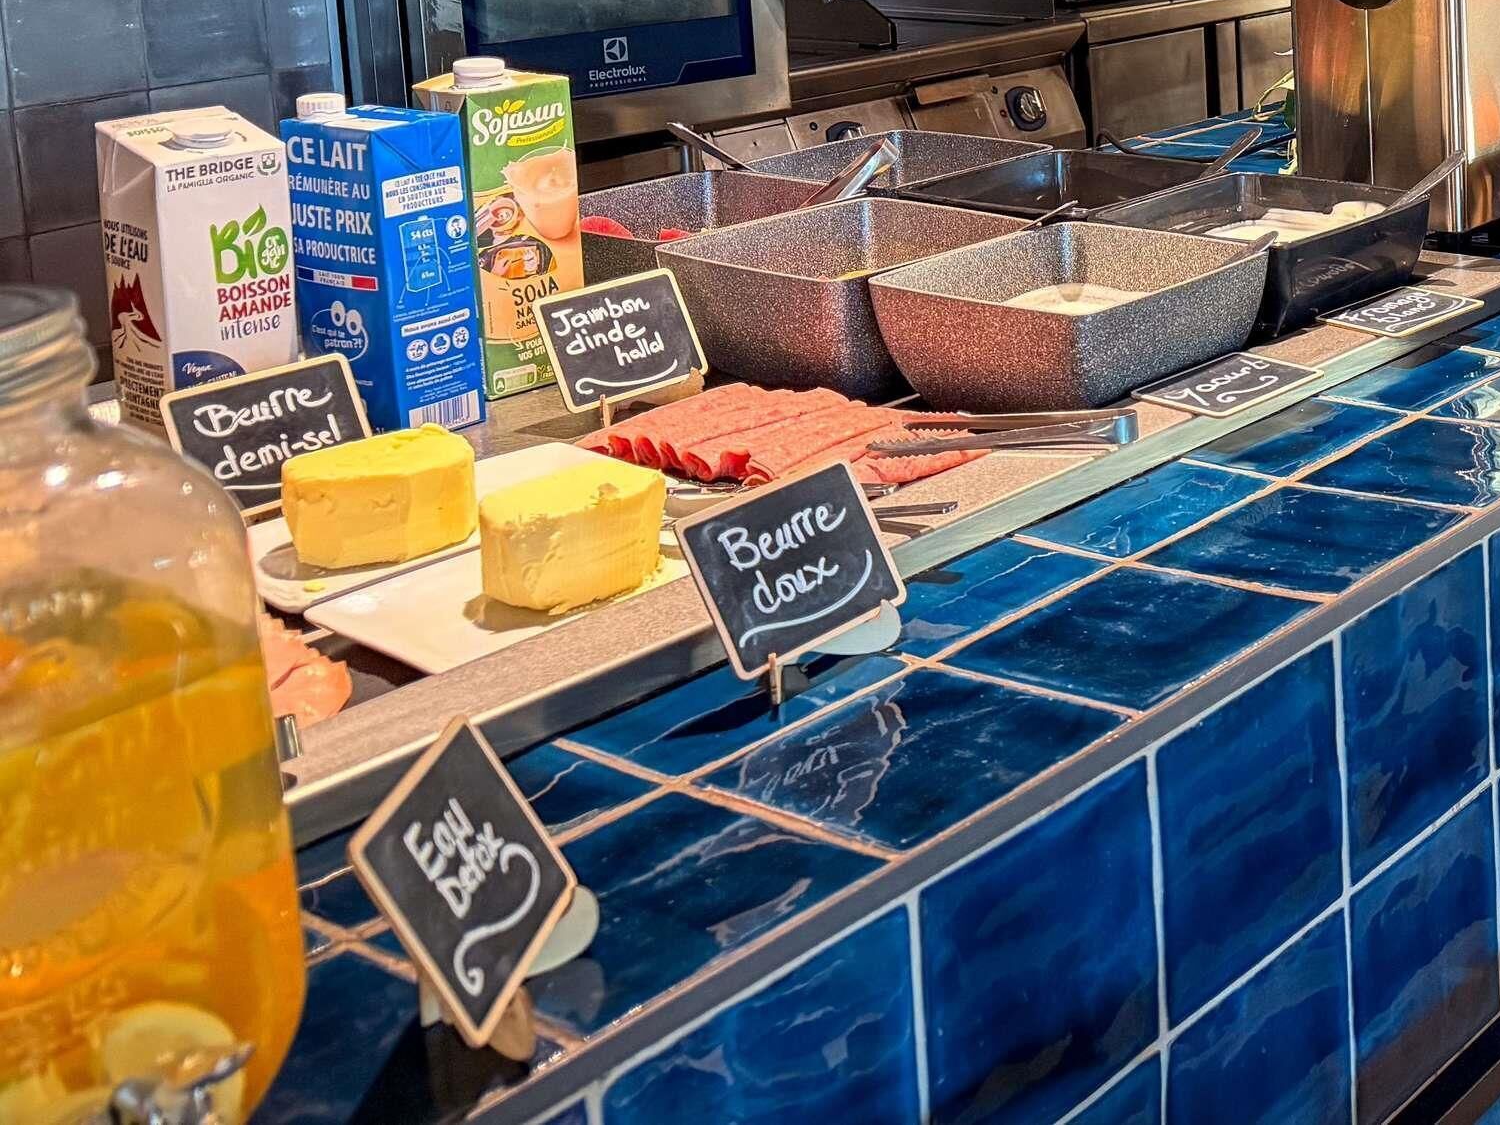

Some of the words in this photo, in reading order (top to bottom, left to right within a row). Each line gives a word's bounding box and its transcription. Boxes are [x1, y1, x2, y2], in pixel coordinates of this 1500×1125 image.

[589, 65, 647, 81] Electrolux
[472, 102, 566, 146] Sojasun
[286, 136, 315, 165] CE
[320, 139, 367, 171] LAIT
[165, 166, 195, 182] THE
[199, 157, 255, 176] BRIDGE
[167, 183, 176, 192] LA
[215, 172, 255, 184] ORGANIC
[352, 183, 370, 200] AU
[292, 202, 332, 231] JUSTE
[336, 209, 373, 235] PRIX
[104, 232, 116, 253] DE
[120, 236, 148, 262] L'EAU
[306, 238, 377, 265] PRODUCTRICE
[217, 274, 291, 305] BOISSON
[512, 276, 559, 306] SOJA
[219, 291, 292, 322] AMANDE
[551, 297, 650, 337] Jambon
[221, 314, 281, 341] intense
[565, 319, 647, 355] dinde
[193, 387, 333, 437] Beurre
[214, 413, 342, 480] demi-sel
[717, 505, 847, 571] Beurre
[753, 556, 840, 614] doux
